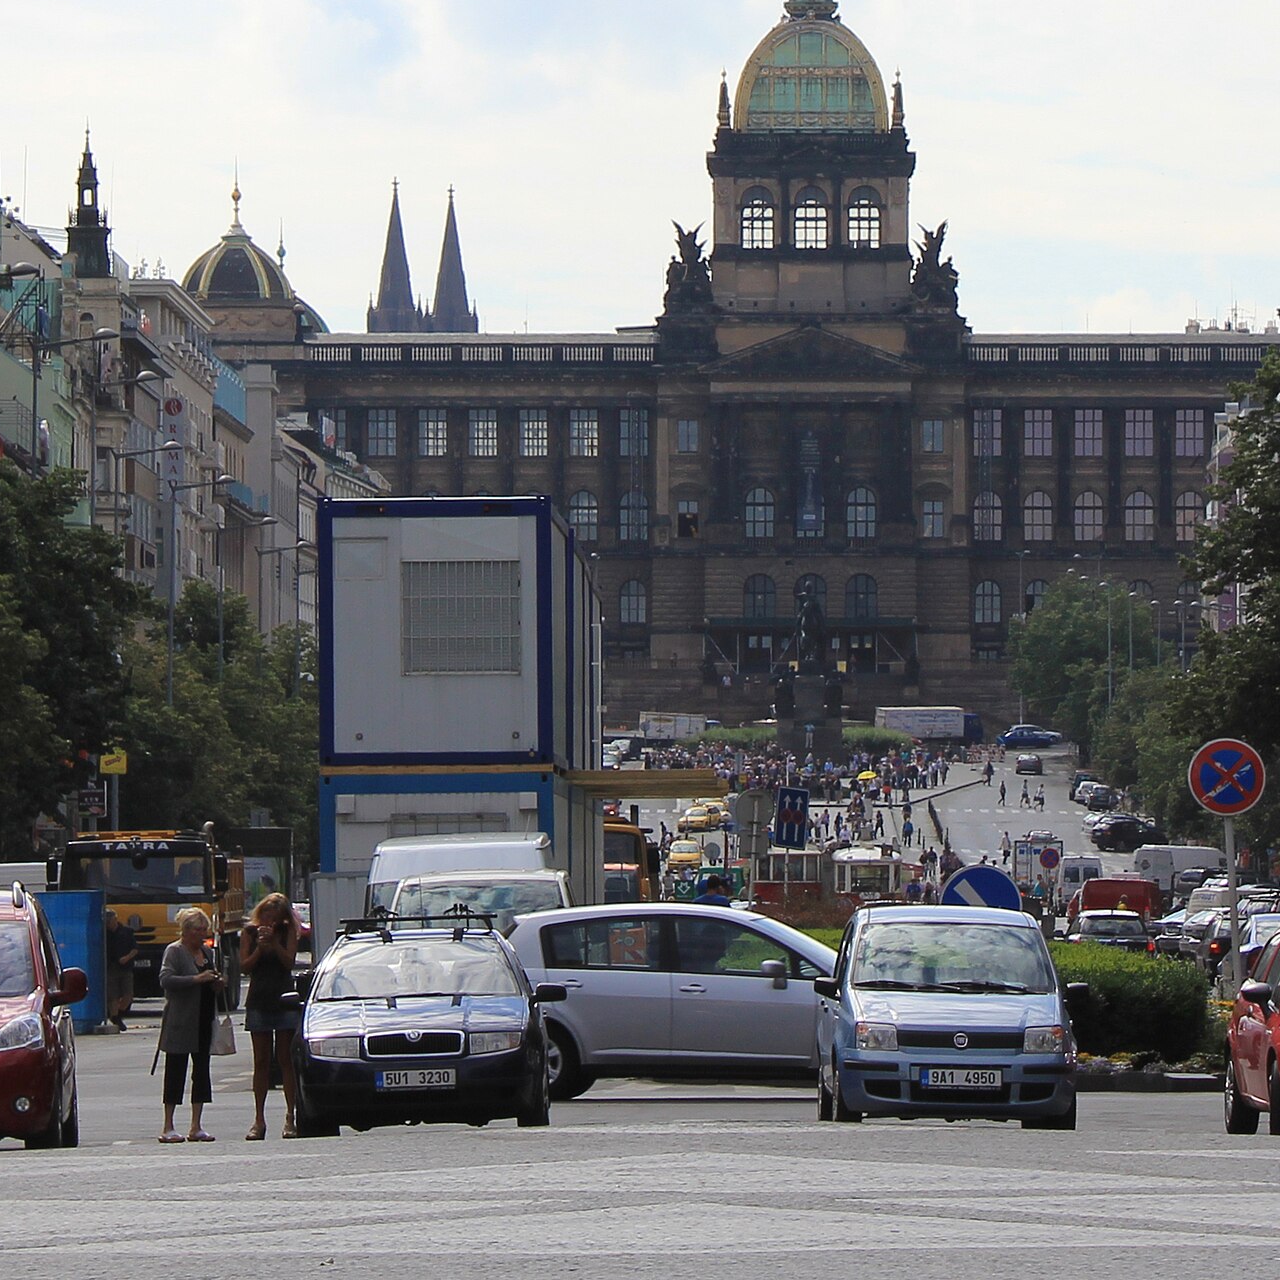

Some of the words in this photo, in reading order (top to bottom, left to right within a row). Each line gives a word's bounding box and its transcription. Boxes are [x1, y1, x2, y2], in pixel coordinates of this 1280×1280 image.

[102, 842, 169, 850] TATRA
[386, 1072, 408, 1085] 5U1
[419, 1071, 450, 1084] 3230
[932, 1071, 954, 1083] 9A1
[965, 1072, 996, 1084] 4950
